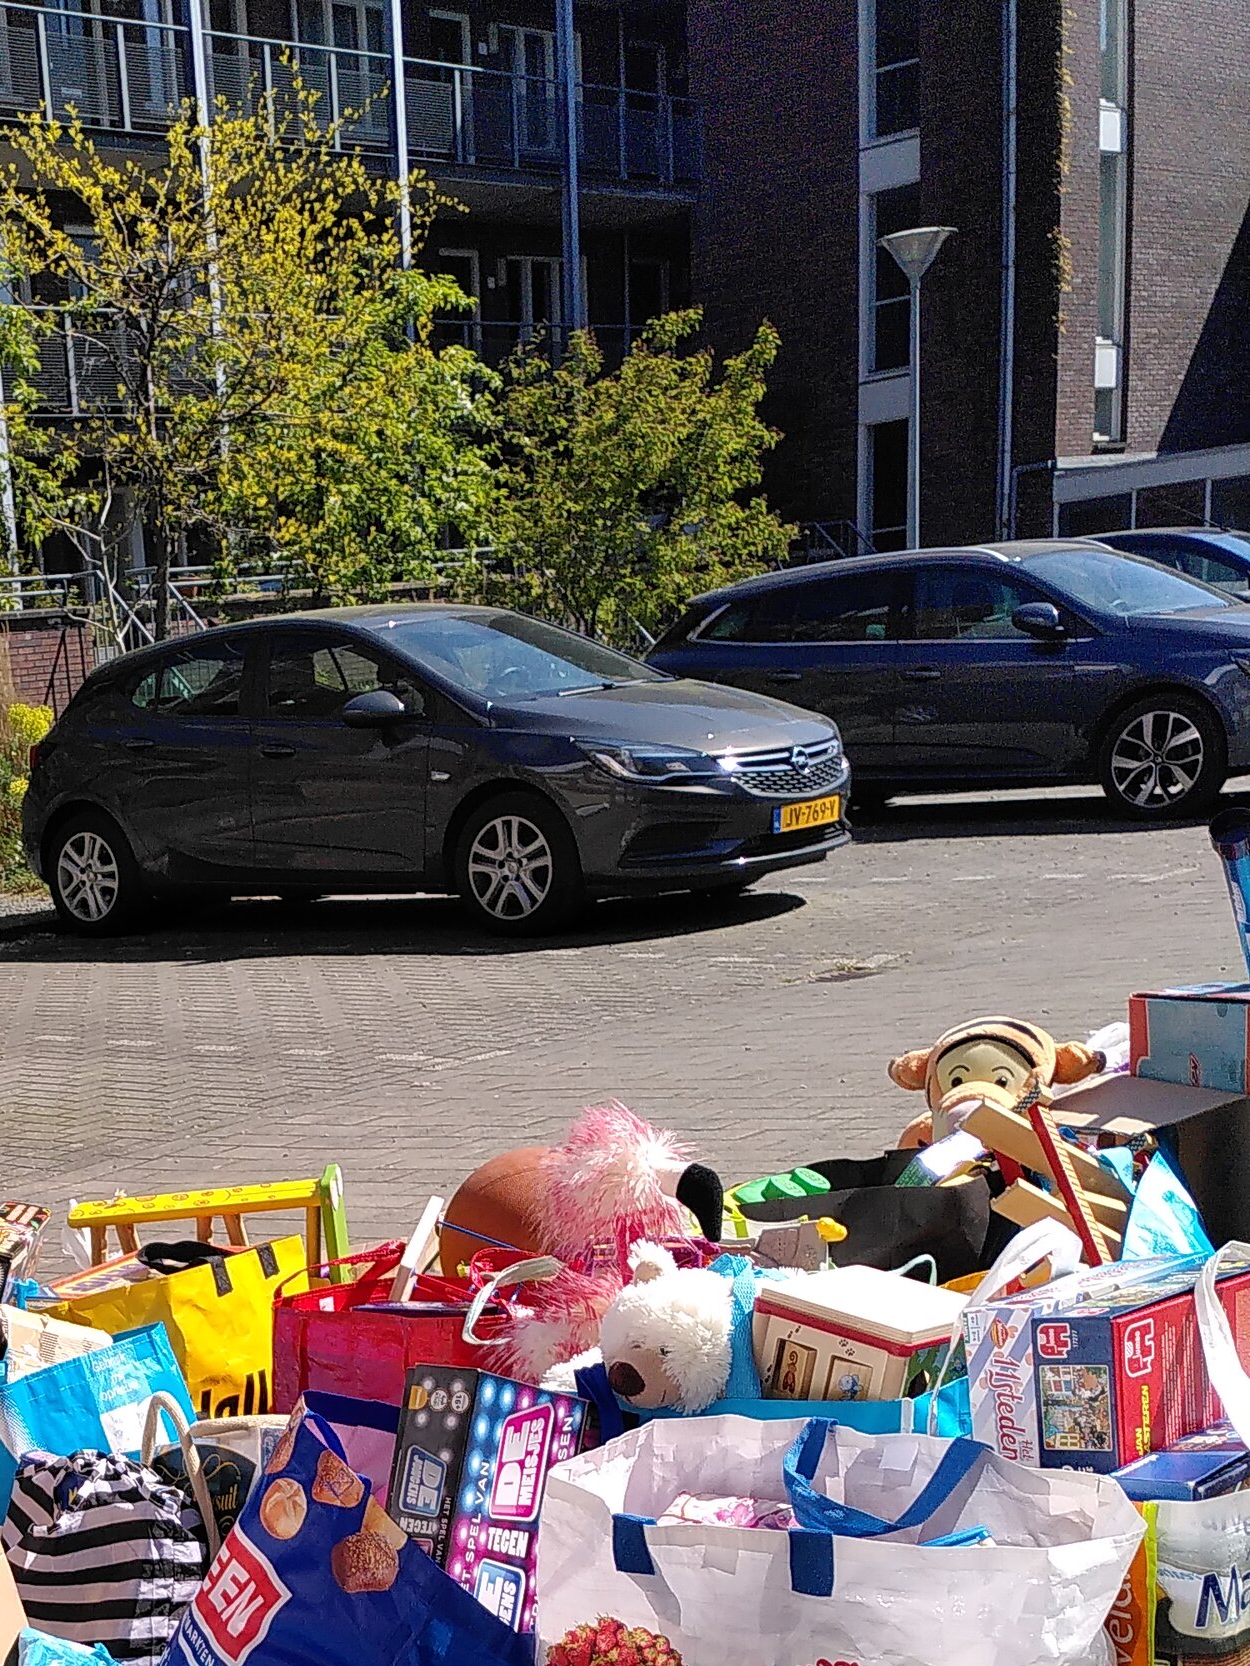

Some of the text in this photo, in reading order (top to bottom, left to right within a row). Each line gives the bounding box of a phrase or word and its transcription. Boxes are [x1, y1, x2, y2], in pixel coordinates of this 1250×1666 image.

[417, 1459, 441, 1511] DE
[495, 1420, 530, 1506] DE
[518, 1417, 545, 1506] MEISJES
[465, 1513, 482, 1562] SPEL
[475, 1461, 491, 1504] VAN
[487, 1527, 530, 1558] TEGEN
